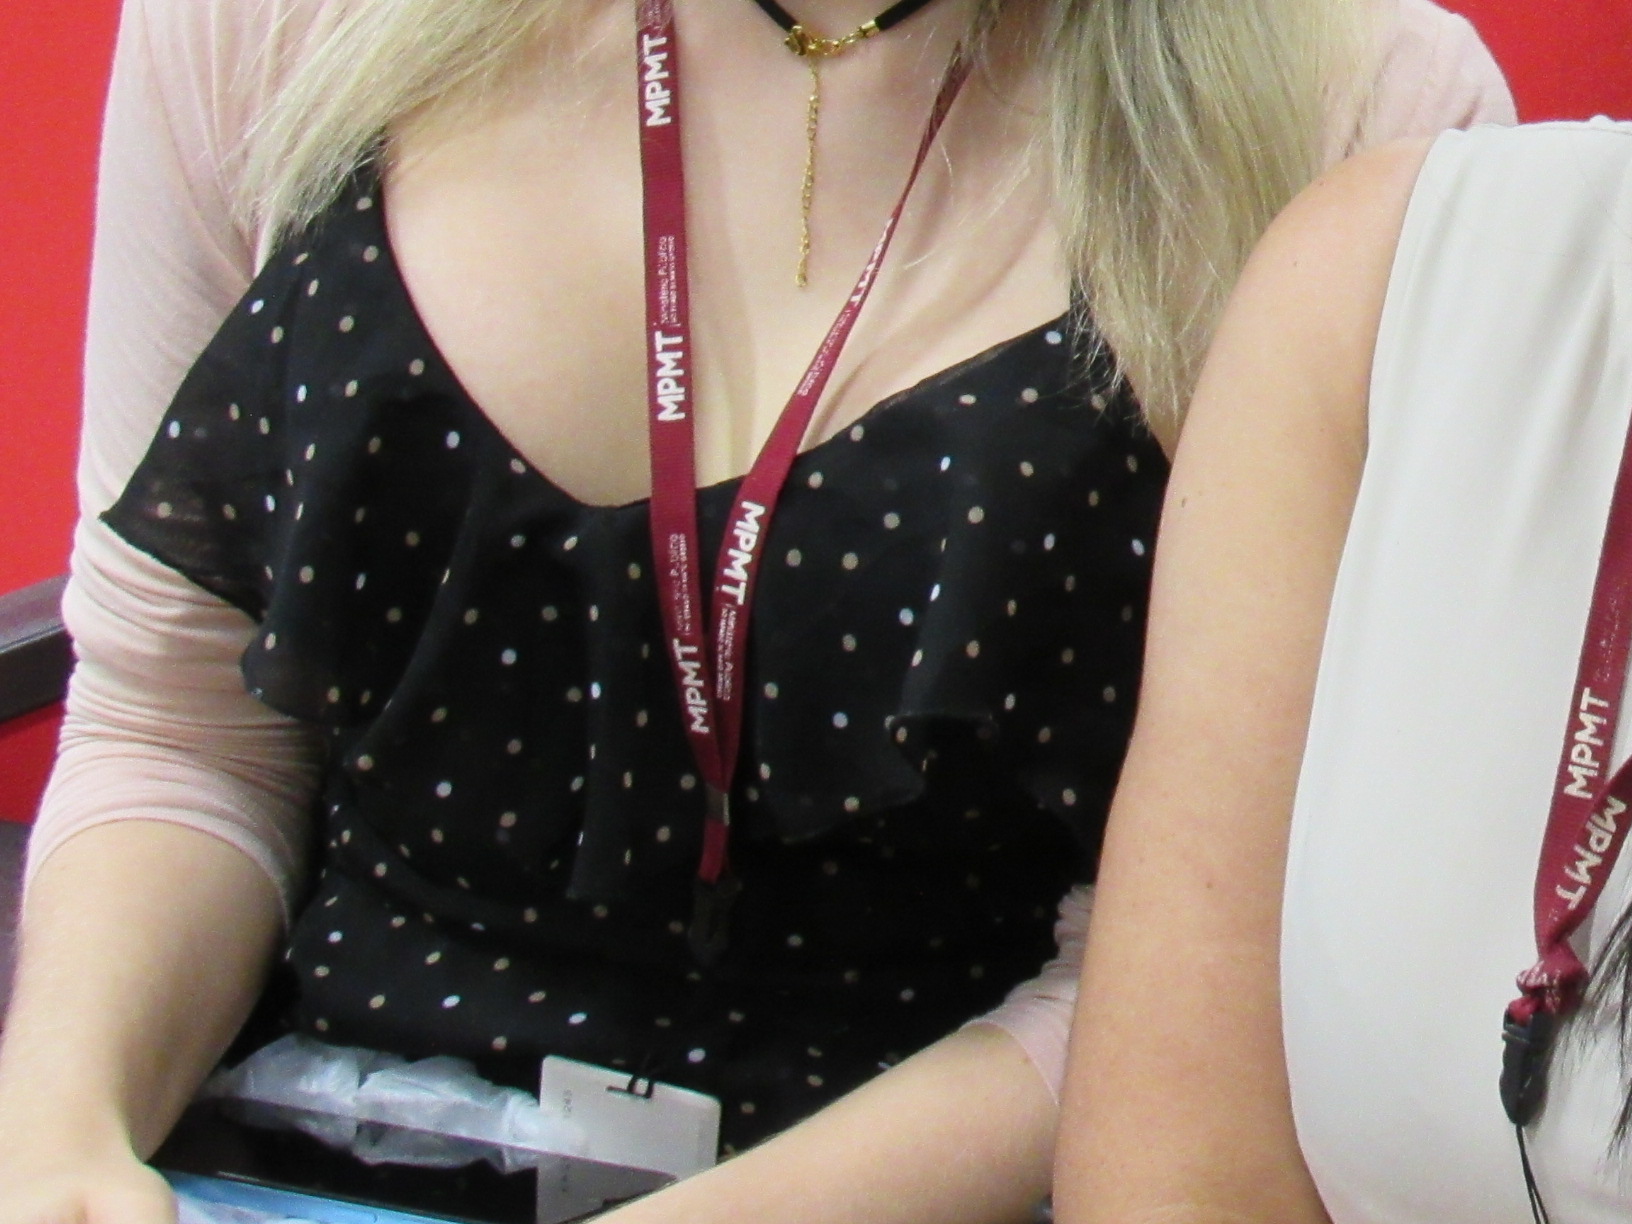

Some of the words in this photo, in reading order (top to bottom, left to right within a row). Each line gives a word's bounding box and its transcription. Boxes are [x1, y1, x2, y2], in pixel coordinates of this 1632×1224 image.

[642, 33, 673, 127] MPMT
[654, 330, 686, 422] MPMT
[720, 500, 766, 606] MPMT
[672, 637, 710, 735] MPMT
[1563, 686, 1610, 799] MPMT
[1555, 794, 1628, 911] MPMT
